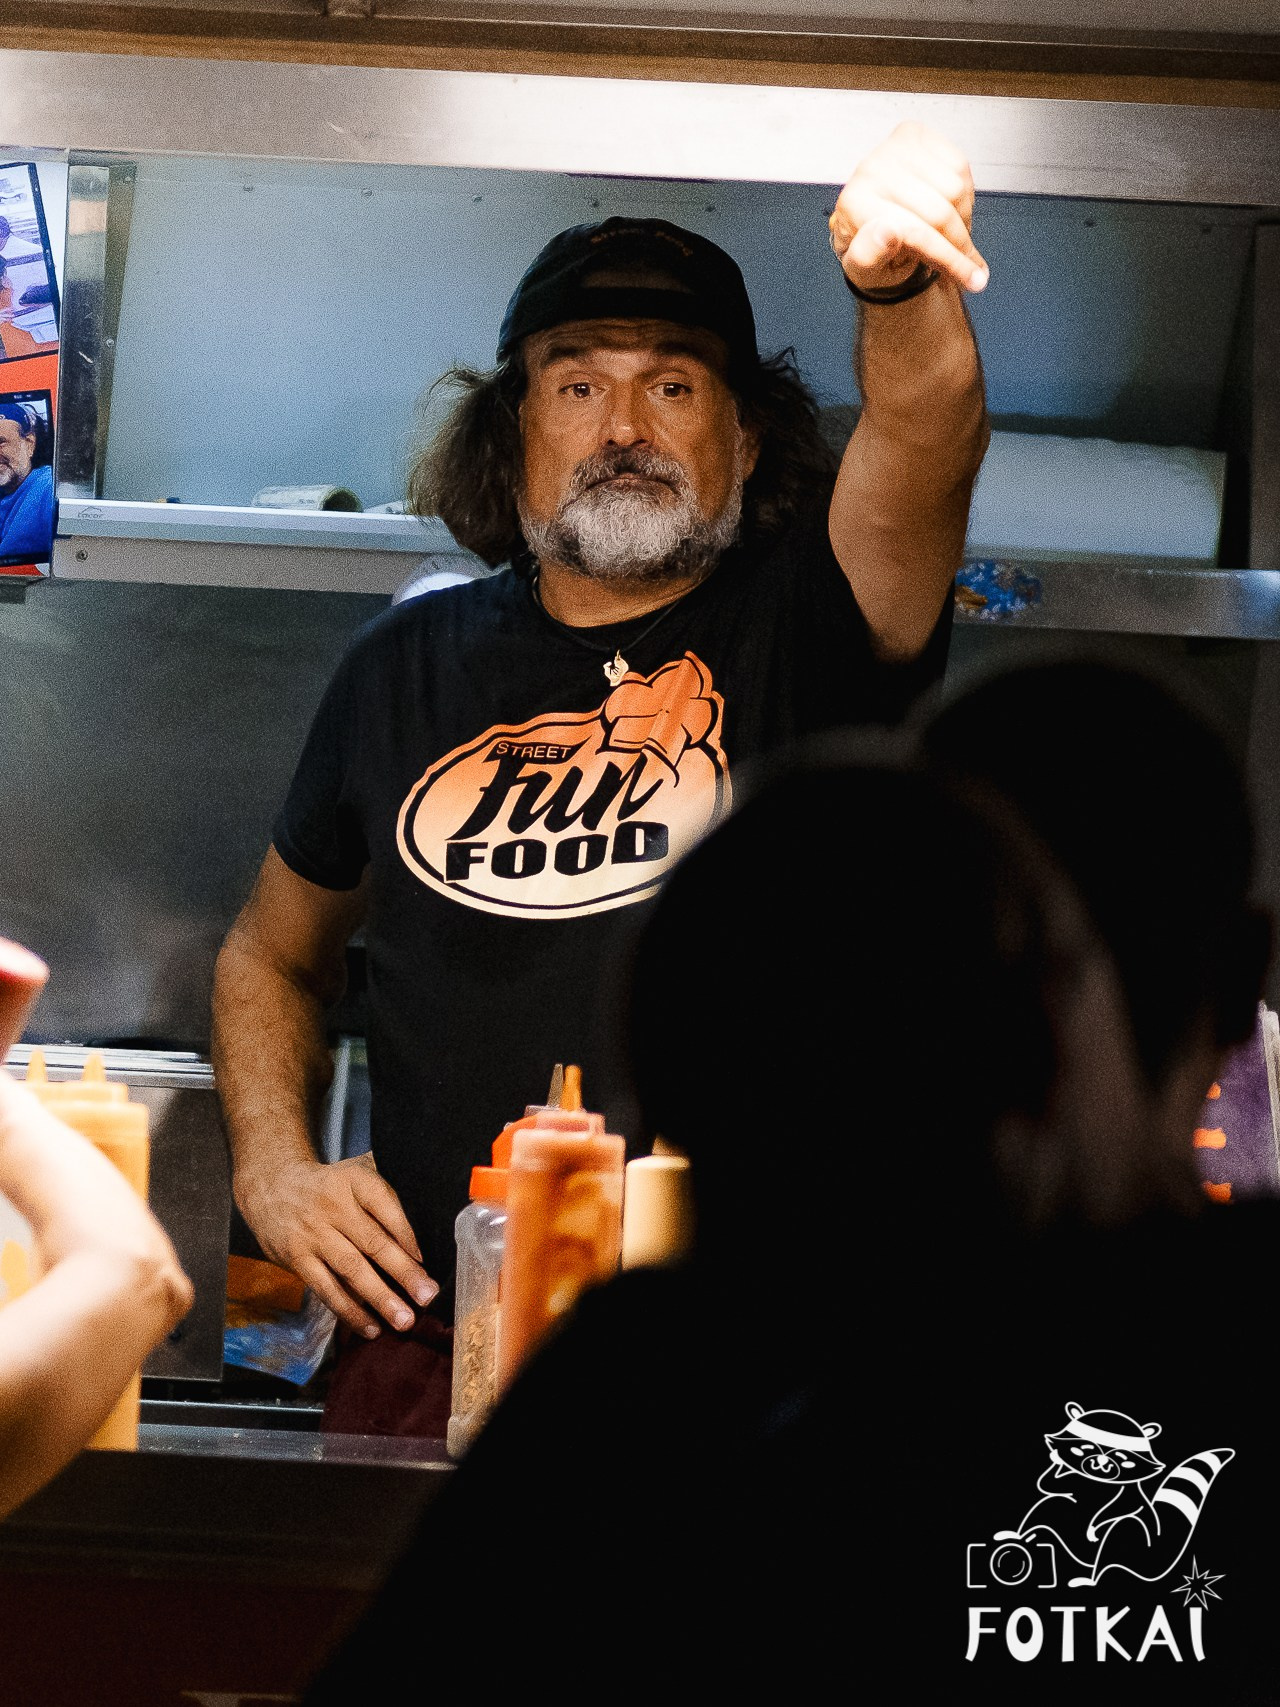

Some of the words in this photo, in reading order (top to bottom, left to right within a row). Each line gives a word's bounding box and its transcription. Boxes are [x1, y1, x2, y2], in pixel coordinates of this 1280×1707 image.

[496, 742, 572, 759] STREET
[445, 747, 664, 841] Fun
[445, 821, 669, 884] FOOD
